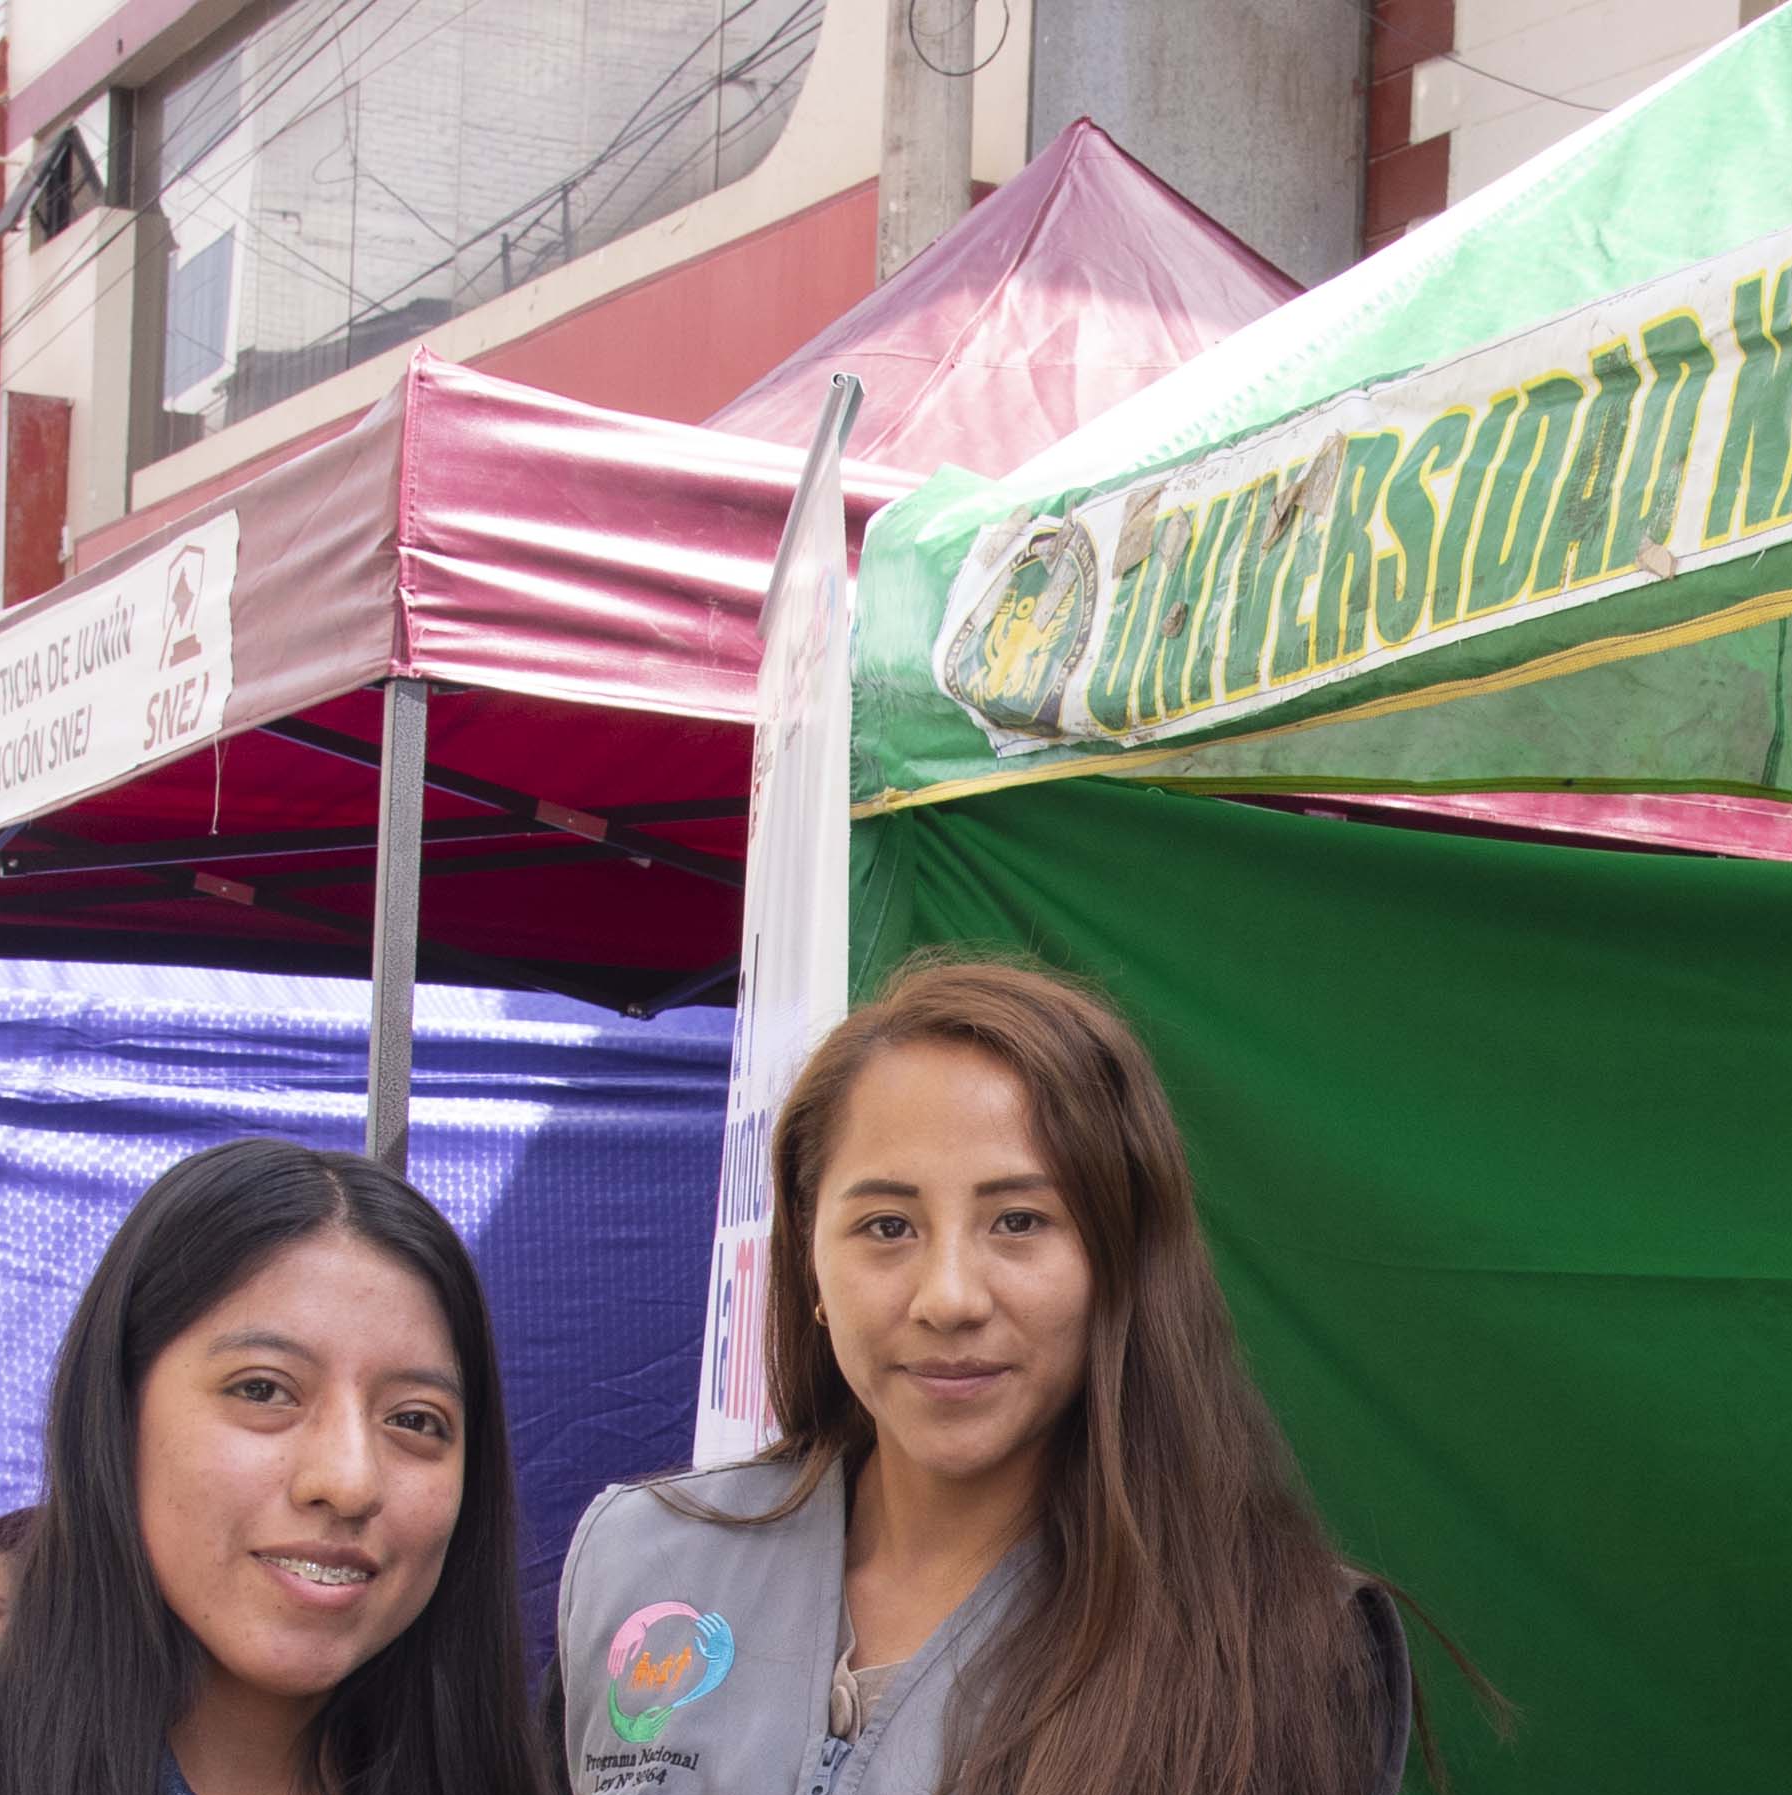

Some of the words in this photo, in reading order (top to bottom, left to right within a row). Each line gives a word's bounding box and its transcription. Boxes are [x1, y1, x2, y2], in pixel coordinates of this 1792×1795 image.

[1081, 303, 1718, 738] UNIVERSIDAD
[45, 634, 72, 692] DE
[73, 598, 136, 678] JUNÍN
[48, 703, 93, 771] SNEJ
[144, 669, 211, 751] SNEJ
[585, 1749, 637, 1773] Programa
[638, 1746, 700, 1772] Nacional
[594, 1774, 616, 1793] Ley
